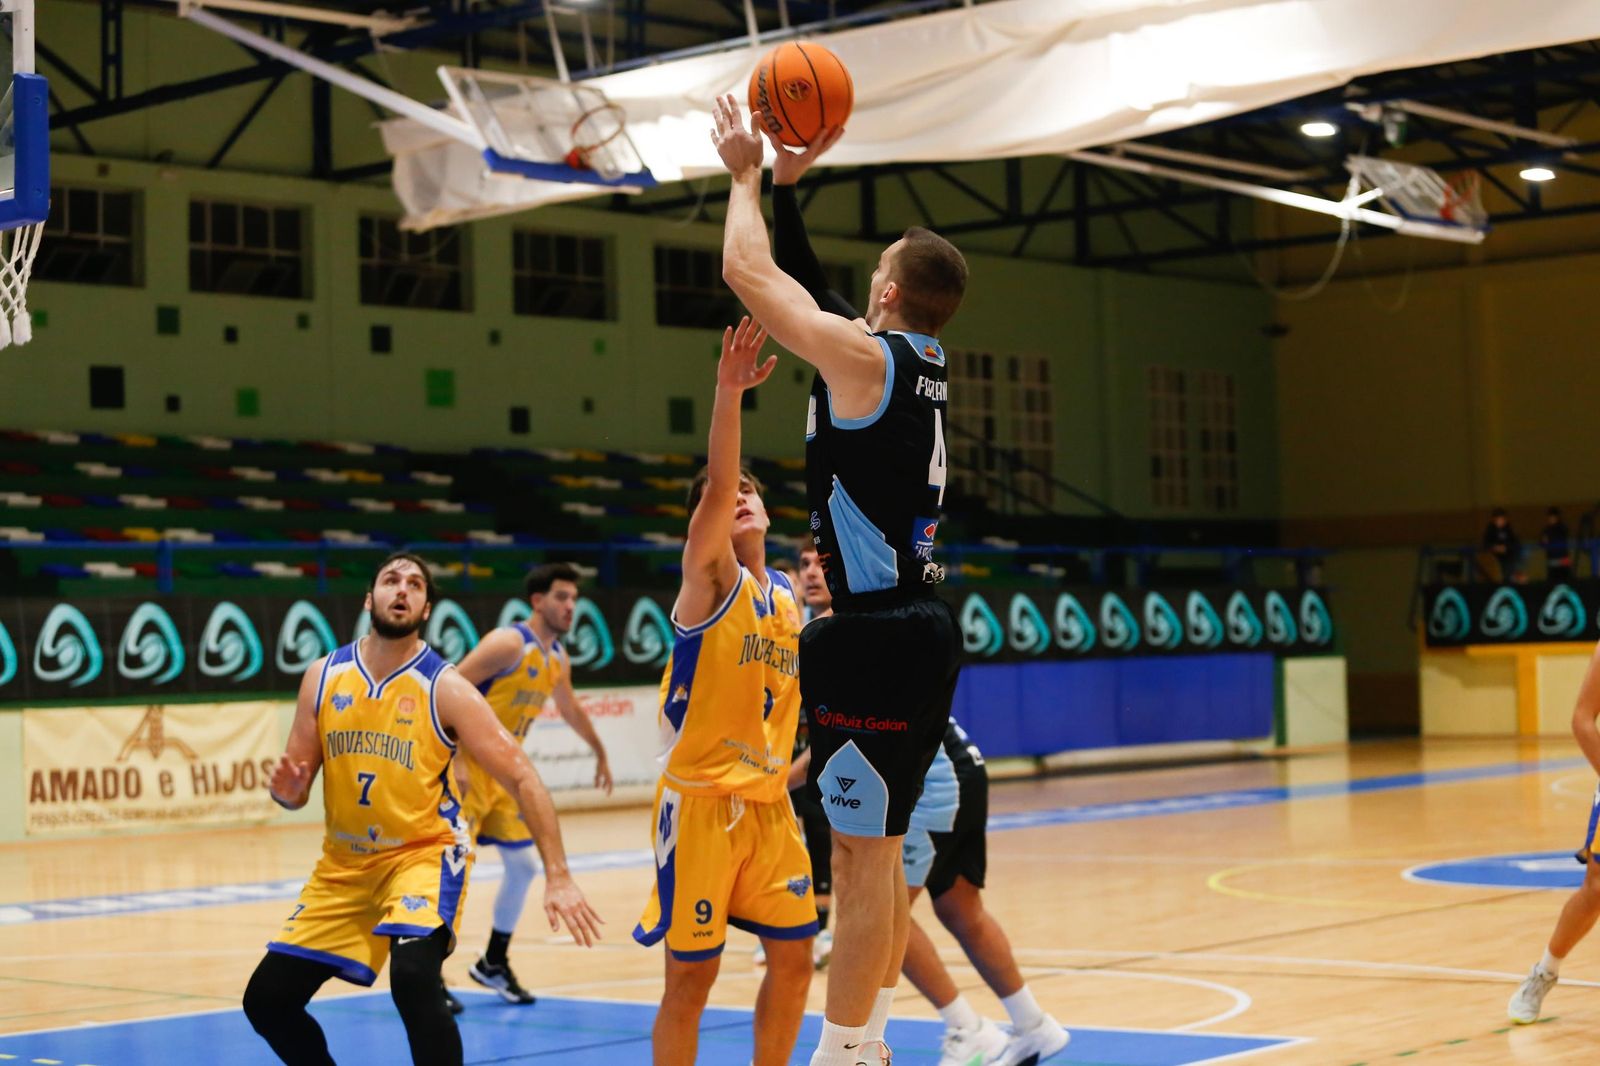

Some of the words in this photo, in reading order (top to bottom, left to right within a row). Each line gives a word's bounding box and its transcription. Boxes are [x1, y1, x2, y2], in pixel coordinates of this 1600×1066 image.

[928, 408, 947, 506] 4
[836, 712, 862, 729] Ruiz
[327, 731, 414, 770] NOVASCHOOL
[29, 767, 142, 803] AMADO
[158, 770, 174, 798] e
[190, 758, 274, 796] HIJOS
[358, 772, 376, 806] 7
[830, 793, 861, 809] vive
[694, 899, 713, 925] 9
[692, 929, 714, 938] vive
